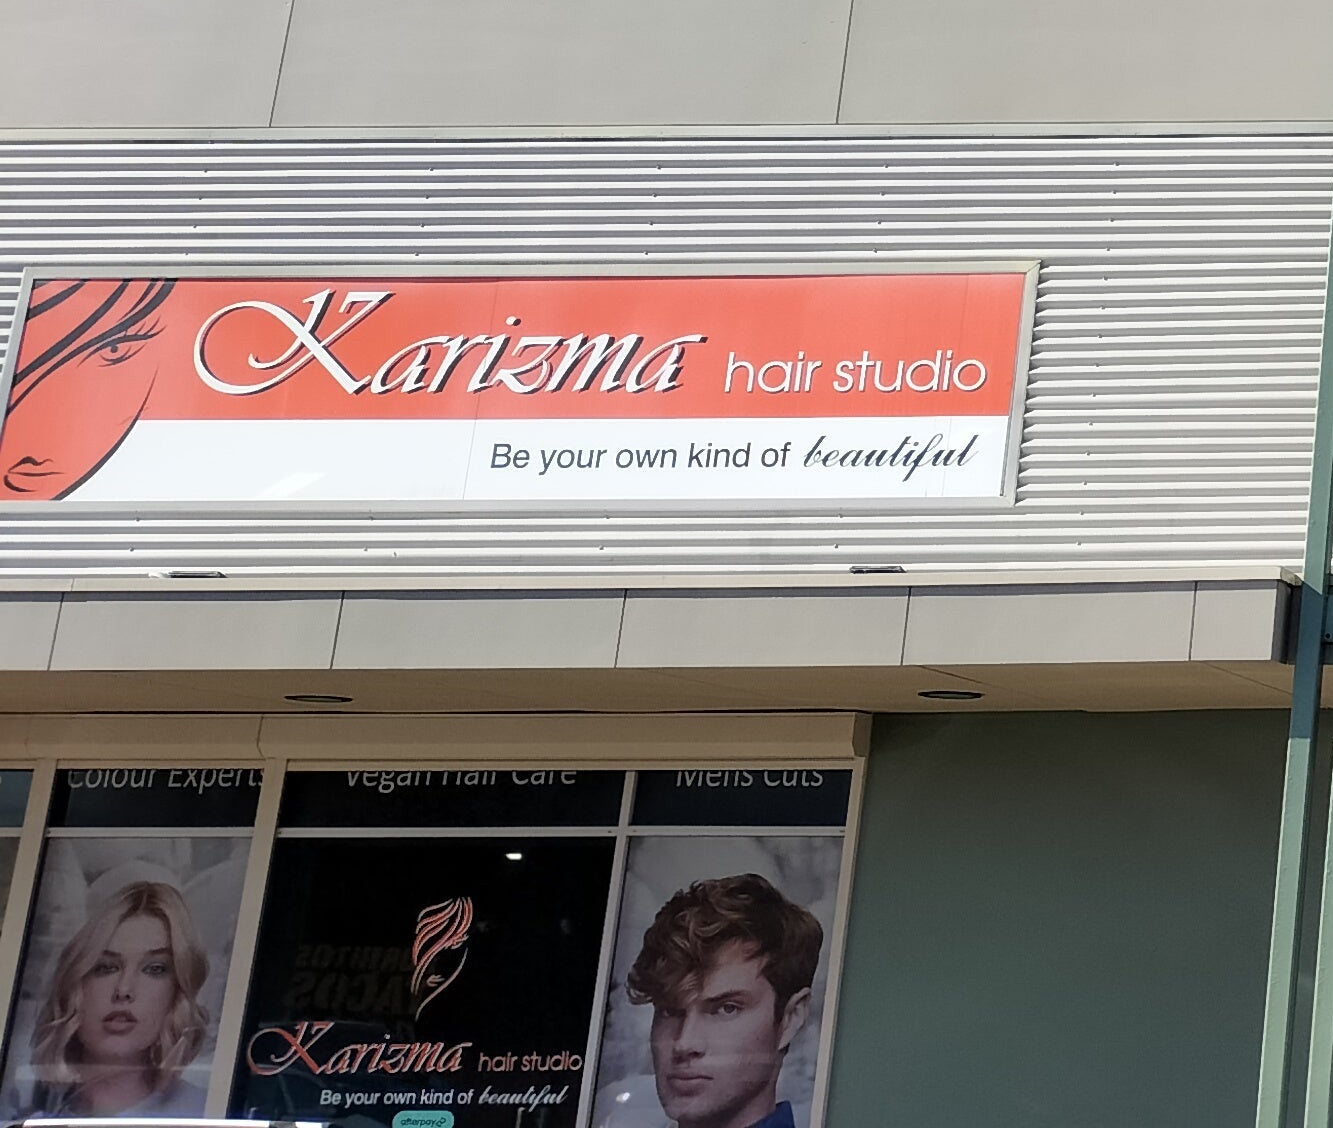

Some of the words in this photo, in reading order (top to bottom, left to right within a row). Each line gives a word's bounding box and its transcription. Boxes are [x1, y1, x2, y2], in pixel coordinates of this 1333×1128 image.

[193, 288, 707, 398] Karizma
[723, 350, 826, 394] hair
[835, 346, 988, 394] studio
[490, 442, 530, 470] Be
[539, 442, 606, 478] your
[614, 442, 678, 469] own
[687, 440, 752, 469] kind
[761, 440, 792, 468] of
[802, 435, 978, 482] beautiful
[247, 1021, 472, 1076] Karizma
[478, 1052, 518, 1072] hair
[521, 1050, 582, 1072] studio
[320, 1089, 341, 1105] Be
[345, 1089, 379, 1112] your
[383, 1091, 416, 1105] own
[420, 1088, 453, 1105] kind
[457, 1088, 474, 1105] of
[478, 1085, 569, 1113] beautiful
